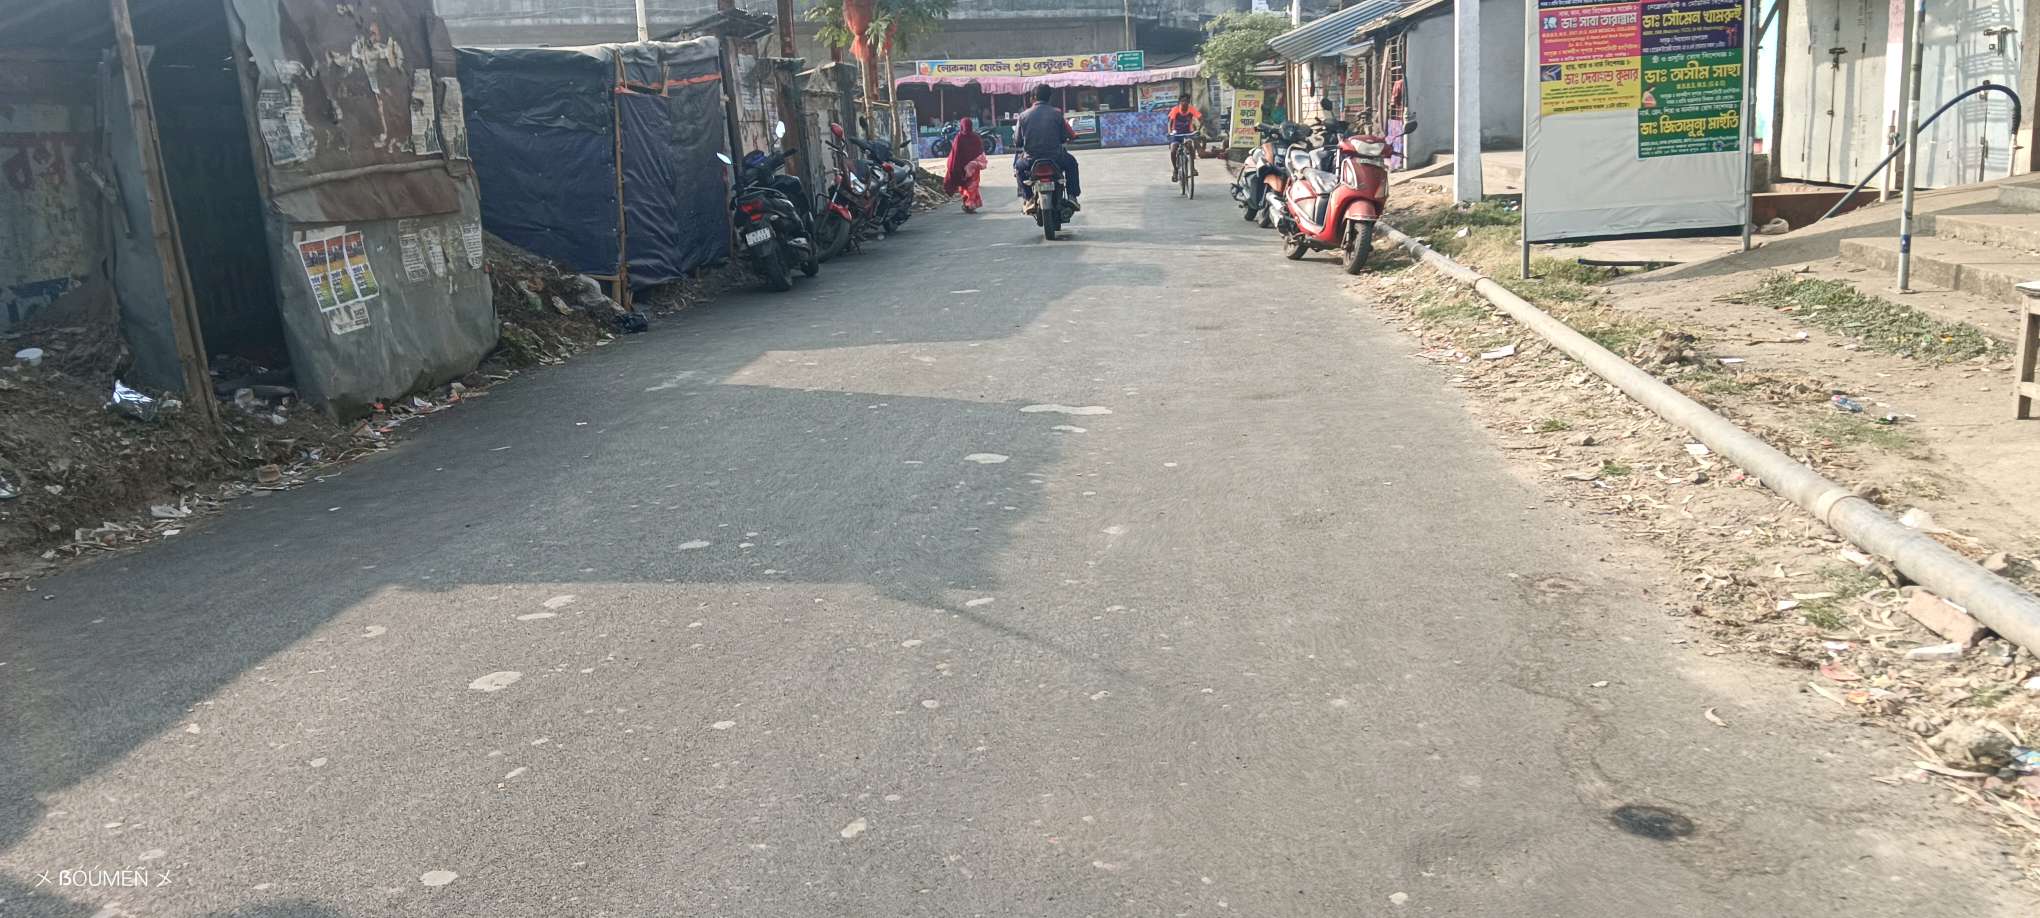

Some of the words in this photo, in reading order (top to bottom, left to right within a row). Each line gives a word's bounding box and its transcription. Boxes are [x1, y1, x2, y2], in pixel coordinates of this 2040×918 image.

[1642, 14, 1660, 28] ডাঃ
[1663, 9, 1700, 26] সৌমেন
[980, 61, 1011, 73] হোটেল
[1644, 69, 1667, 83] ডাঃ
[1670, 60, 1710, 81] অসীম
[1712, 63, 1742, 78] সাহা
[1640, 122, 1657, 136] ডাঃ
[1708, 110, 1739, 130] মাইতি
